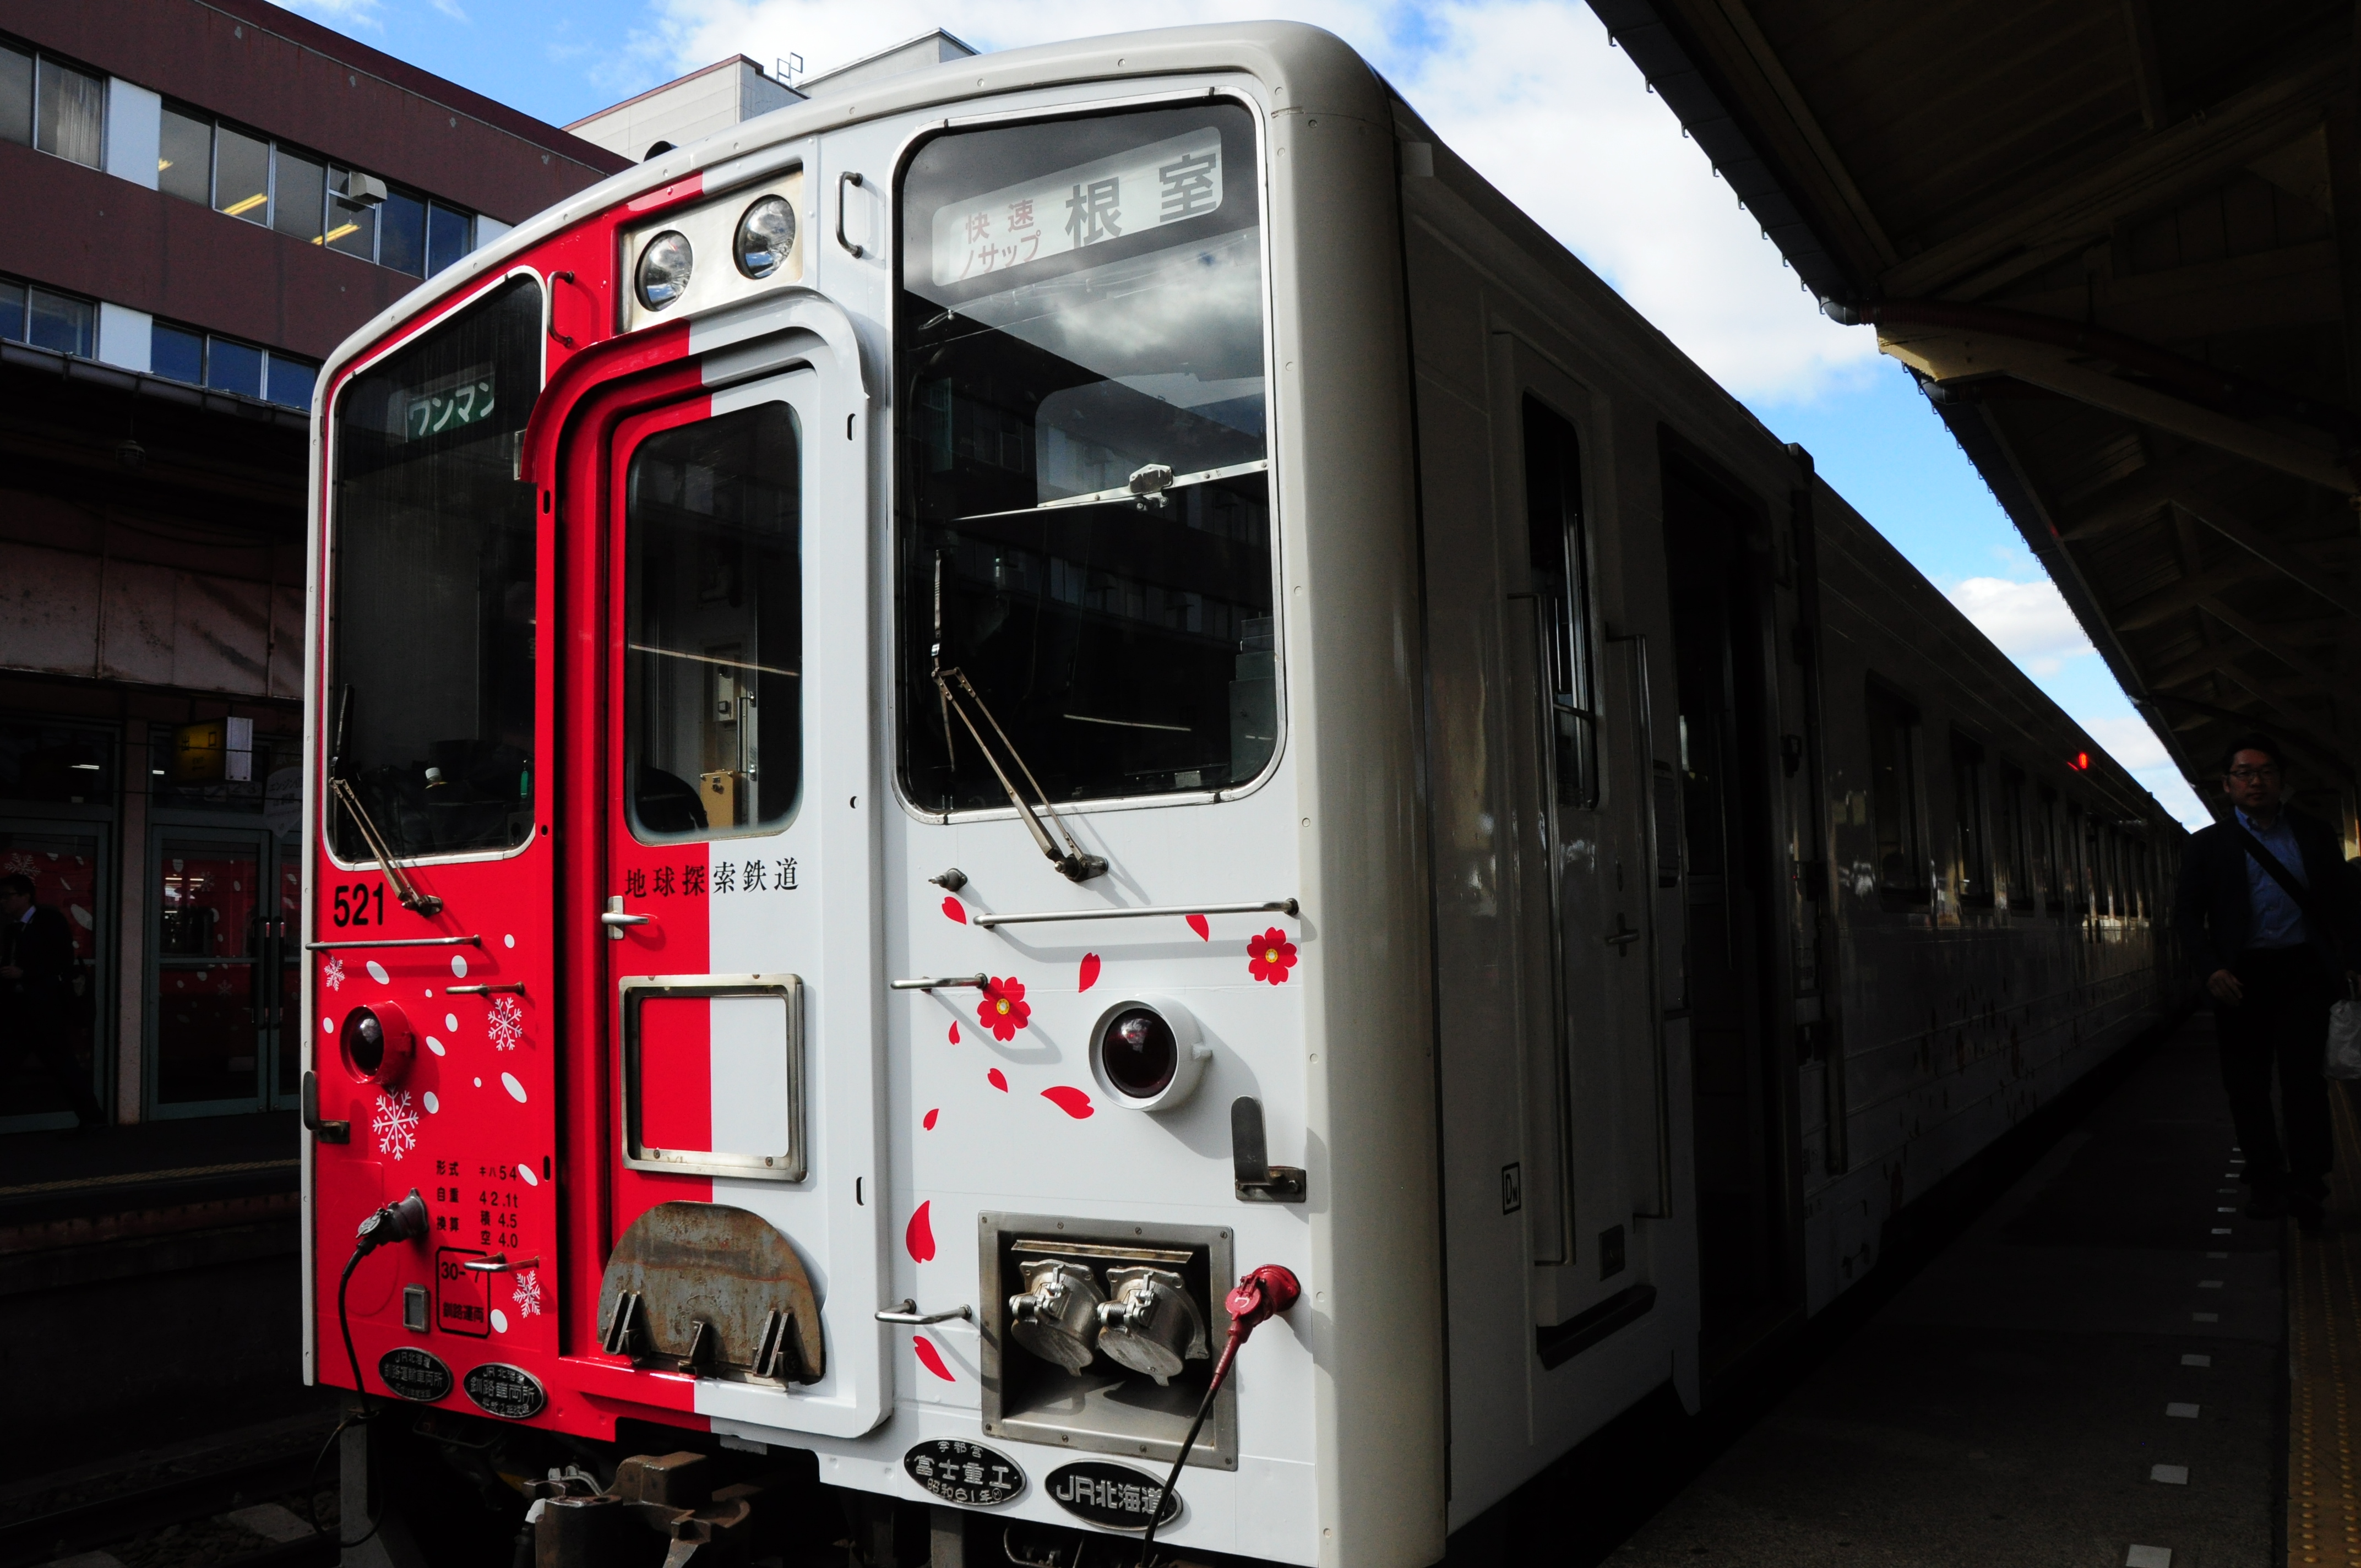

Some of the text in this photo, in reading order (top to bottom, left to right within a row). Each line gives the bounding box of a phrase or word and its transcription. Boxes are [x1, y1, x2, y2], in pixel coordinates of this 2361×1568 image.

[1065, 153, 1217, 247] 根室
[965, 198, 1035, 244] 快速
[959, 229, 1042, 280] ノサップ
[409, 382, 494, 436] ワンマン
[624, 857, 799, 898] 地球探索鉄道
[334, 882, 383, 927] 521
[437, 1160, 517, 1180] 形式 キハ54
[437, 1187, 518, 1208] 自重 42.1t
[437, 1210, 517, 1232] 換算 積 4.5
[481, 1230, 518, 1248] 空 4.0
[394, 1351, 431, 1369] JR北海道
[483, 1366, 525, 1385] JR北海道
[470, 1376, 536, 1404] 釧路車両所
[937, 1440, 983, 1458] 宇都宮
[913, 1455, 1012, 1490] 富士重工
[1056, 1474, 1165, 1516] JR北海道
